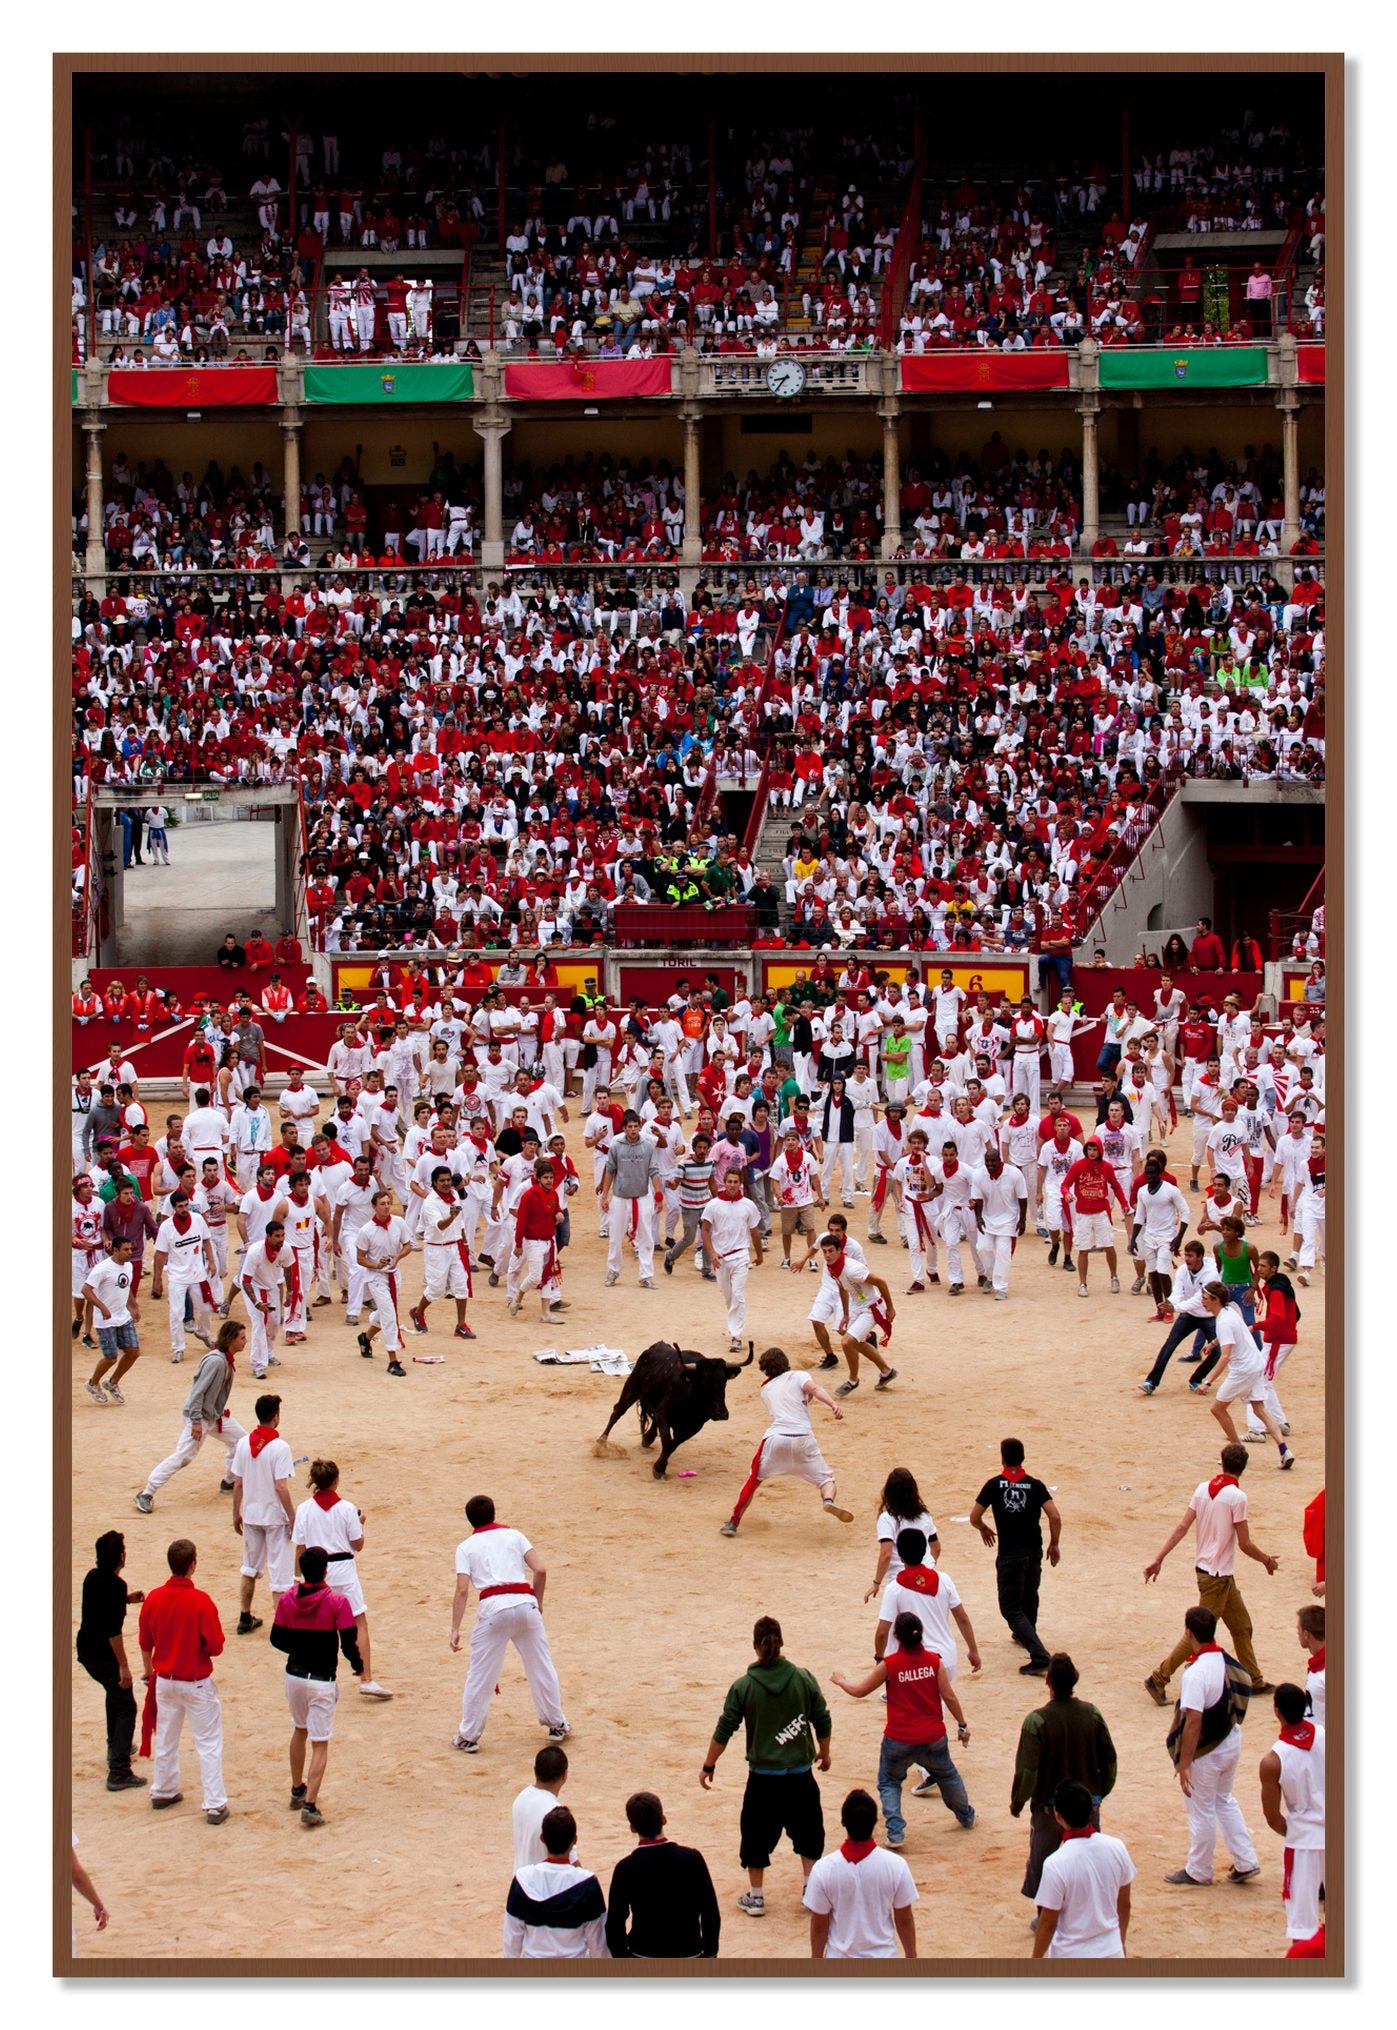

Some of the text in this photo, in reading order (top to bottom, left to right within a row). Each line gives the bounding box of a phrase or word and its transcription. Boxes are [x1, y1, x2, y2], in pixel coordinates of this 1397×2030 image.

[662, 958, 696, 967] TORIL
[969, 974, 983, 991] 6
[898, 1666, 935, 1683] GALLEGA
[775, 1713, 807, 1745] INEFC
